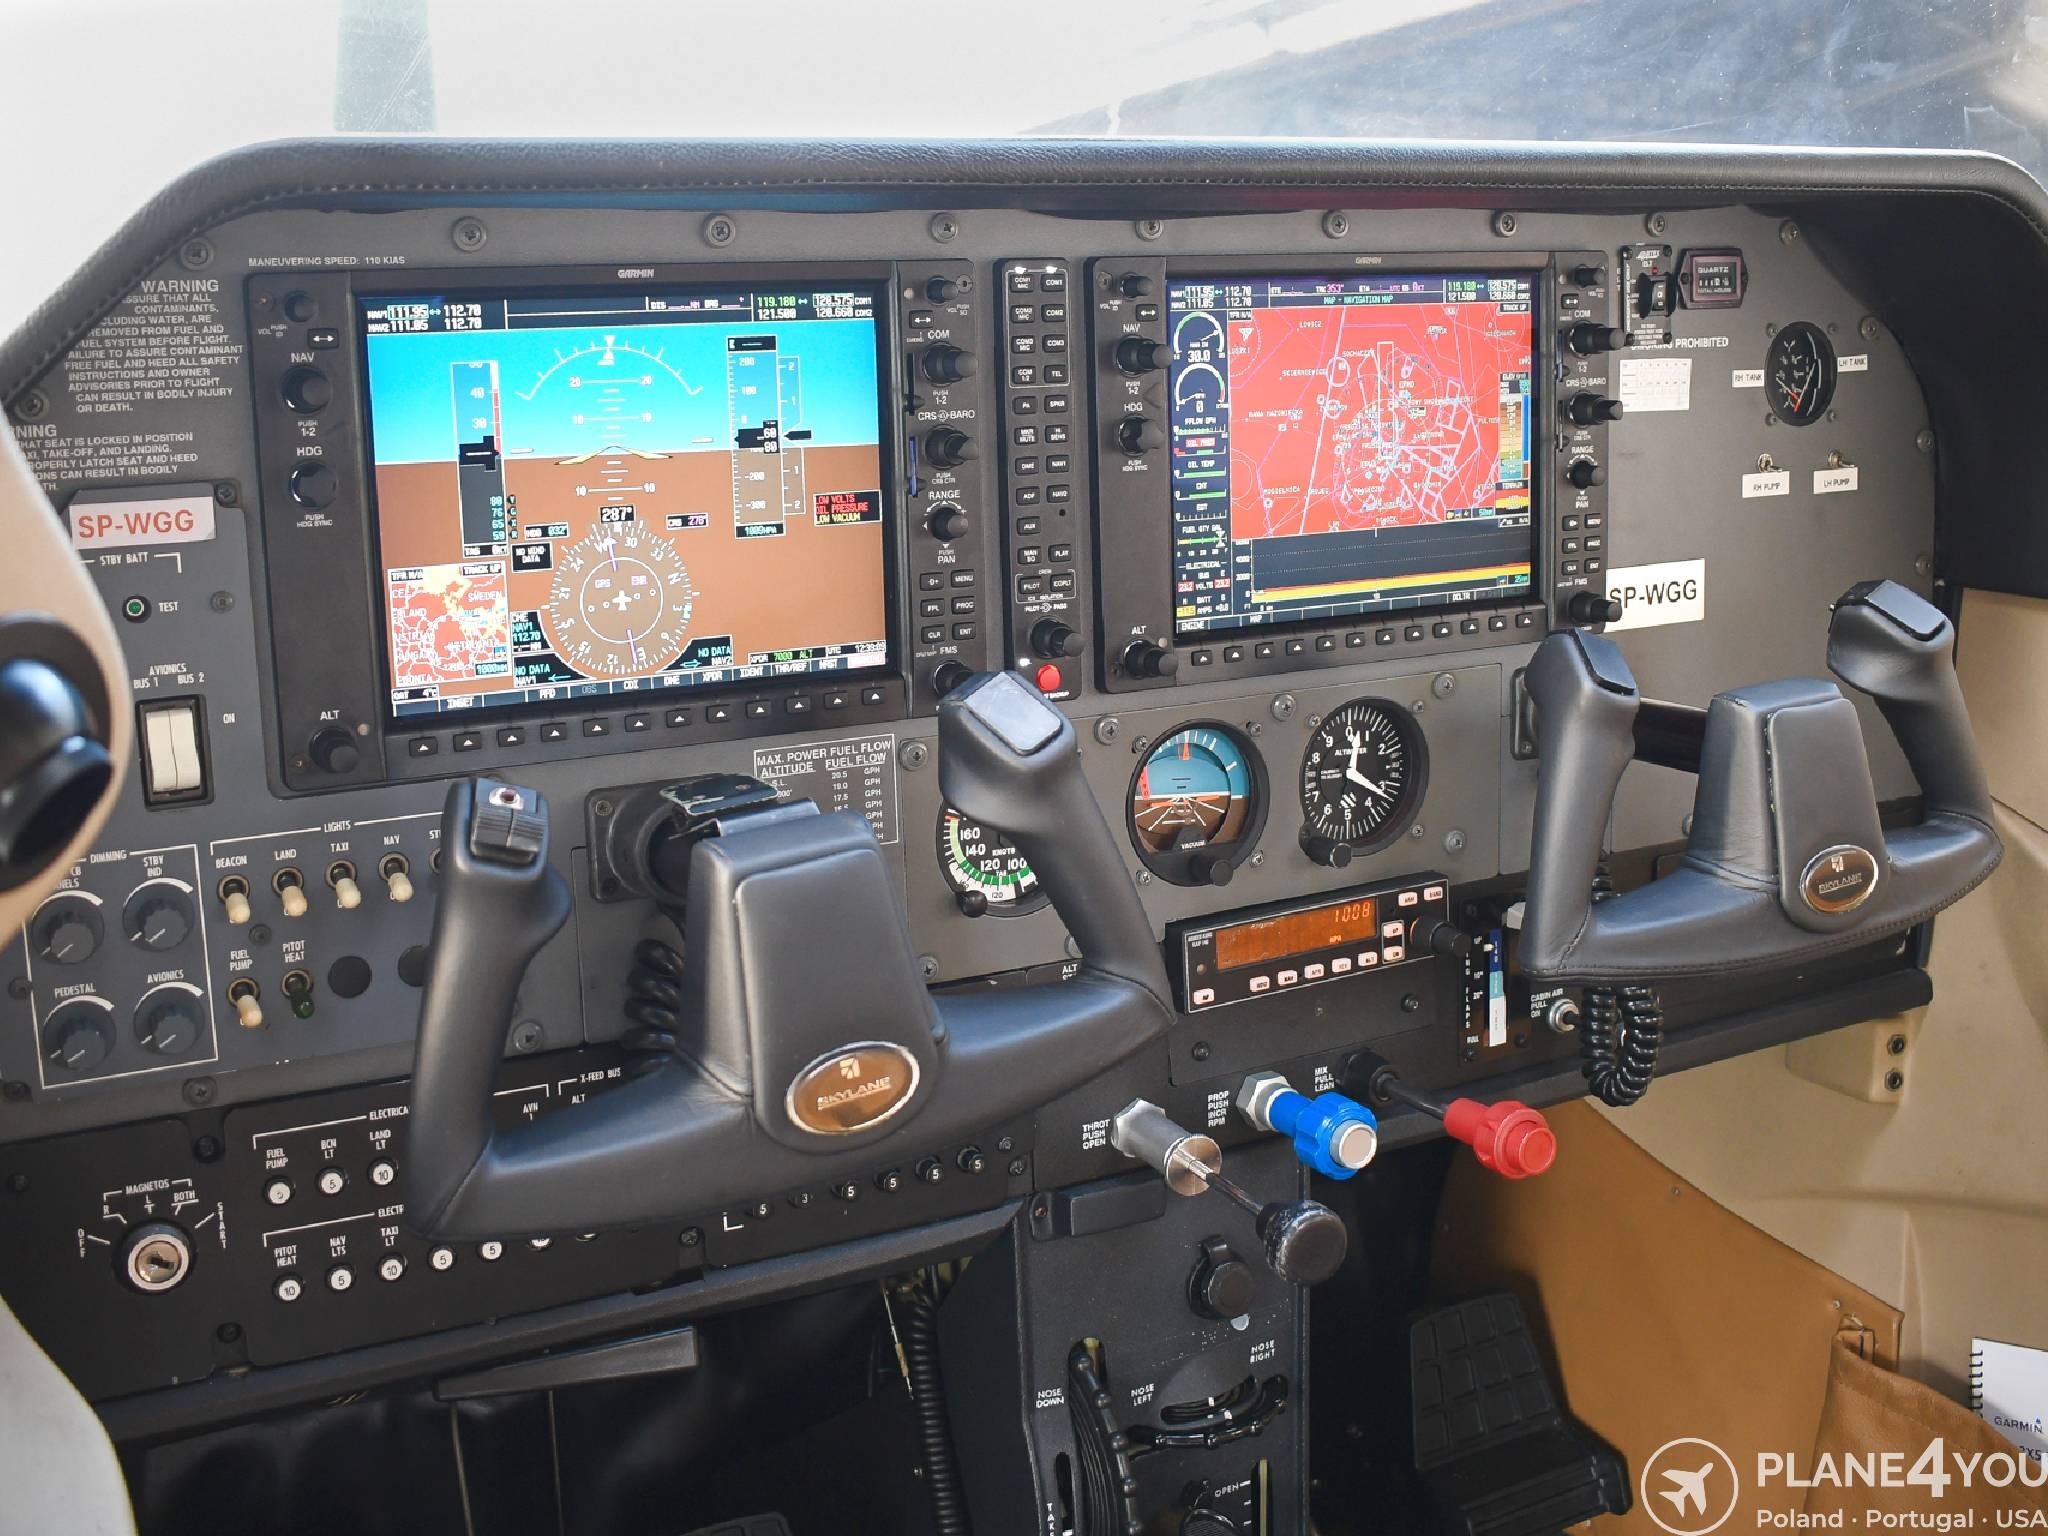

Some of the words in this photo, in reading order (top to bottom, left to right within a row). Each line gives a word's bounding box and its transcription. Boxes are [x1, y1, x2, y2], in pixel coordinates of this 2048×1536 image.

[249, 257, 321, 267] MANEUVERING
[365, 256, 381, 264] 110
[383, 256, 405, 264] KIAS
[618, 269, 654, 278] GARMIN
[142, 279, 219, 292] WARNING
[1123, 324, 1140, 332] NAV
[928, 330, 950, 339] COM
[1675, 337, 1729, 348] PROHIBITED
[126, 348, 167, 357] ASSURE
[170, 345, 242, 355] CONTAMINANT
[64, 362, 92, 370] FREE
[95, 361, 121, 369] FUEL
[124, 360, 146, 368] AND
[150, 358, 176, 367] HEED
[201, 356, 239, 364] SAFETY
[291, 353, 314, 363] NAV
[1839, 359, 1847, 367] LH
[1849, 358, 1866, 367] TANK
[69, 371, 145, 380] INSTRUCTIONS
[148, 369, 169, 377] AND
[172, 368, 210, 376] OWNER
[69, 381, 130, 391] ADVISORIES
[134, 380, 165, 388] PRIOR
[168, 380, 181, 388] TO
[185, 378, 220, 387] FLIGHT
[76, 394, 98, 402] CAN
[102, 392, 141, 400] RESULT
[144, 391, 154, 399] IN
[158, 390, 194, 398] BODILY
[198, 388, 232, 397] INJURY
[95, 402, 133, 412] DEATH.
[1124, 403, 1142, 412] HDG
[44, 438, 72, 447] SEAT
[75, 438, 84, 446] IS
[88, 436, 129, 445] LOCKED
[133, 435, 142, 443] IN
[146, 432, 192, 442] POSITION
[297, 447, 322, 456] HDG
[1572, 446, 1594, 454] RANGE
[1824, 480, 1831, 488] LH
[1833, 479, 1849, 487] PUMP
[816, 497, 829, 505] LOW
[832, 495, 855, 503] VOLTS
[928, 490, 960, 500] RANGE
[816, 506, 829, 514] OIL
[831, 503, 868, 512] PRESSURE
[79, 509, 193, 538] SP-WGG
[816, 515, 829, 523] LOW
[832, 513, 860, 521] VACUUM
[100, 555, 121, 565] STBY
[126, 552, 148, 563] BATT
[938, 556, 955, 564] PAN
[1609, 579, 1697, 608] SP-WGG
[159, 602, 177, 612] TEST
[512, 623, 532, 632] NAV1
[1132, 626, 1146, 634] ALT
[698, 648, 709, 656] NO
[774, 652, 792, 661] 7000
[150, 664, 186, 675] AVIONICS
[515, 666, 526, 676] NO
[529, 664, 550, 674] DATA
[740, 669, 763, 677] IDENT
[703, 672, 722, 681] XPDR
[223, 714, 234, 723] ON
[320, 710, 339, 719] ALT
[757, 754, 784, 766] MAX.
[788, 749, 826, 762] POWER
[830, 746, 857, 756] FUEL
[861, 740, 890, 753] FLOW
[762, 762, 814, 776] ALTITUDE
[826, 757, 852, 768] FUEL
[856, 753, 886, 765] FLOW
[864, 766, 880, 774] GPH
[864, 778, 880, 786] GPH
[865, 789, 881, 797] GPH
[325, 821, 351, 832] LIGHTS
[960, 828, 980, 840] 160
[384, 835, 400, 845] NAV
[331, 842, 349, 853] TAXI
[966, 844, 986, 856] 140
[91, 850, 127, 863] DIMMING
[276, 849, 296, 860] LAND
[144, 856, 164, 866] STBY
[216, 856, 247, 867] BEACON
[980, 860, 1000, 872] 120
[1008, 858, 1027, 870] 100
[147, 867, 162, 877] IND
[1334, 902, 1370, 923] 1008
[283, 941, 305, 952] PITOT
[231, 950, 248, 959] FUEL
[285, 951, 304, 962] HEAT
[230, 959, 252, 971] PUMP
[1062, 964, 1077, 974] ALT
[148, 970, 184, 983] AVIONICS
[55, 985, 96, 997] PEDESTAL
[1531, 992, 1550, 1001] CABIN
[1551, 988, 1563, 997] AIR
[1531, 1002, 1547, 1010] PULL
[1531, 1010, 1541, 1018] ON
[1314, 1066, 1328, 1076] MIX
[1315, 1074, 1332, 1084] PULL
[1314, 1082, 1334, 1092] LEAN
[817, 1076, 891, 1110] SKYLANE
[1208, 1090, 1228, 1102] PROP
[1208, 1100, 1228, 1110] PUSH
[1208, 1108, 1226, 1118] INCR
[1082, 1119, 1110, 1132] THROT
[1208, 1117, 1225, 1127] RPM
[369, 1130, 390, 1140] LAND
[1082, 1130, 1106, 1140] PUSH
[1082, 1138, 1106, 1150] OPEN
[267, 1149, 285, 1158] FUEL
[266, 1157, 287, 1168] PUMP
[126, 1180, 169, 1194] MAGNETOS
[174, 1190, 195, 1201] BOTH
[381, 1226, 398, 1237] TAXI
[330, 1236, 346, 1246] NAV
[274, 1246, 297, 1256] PITOT
[276, 1255, 297, 1265] HEAT
[1252, 1340, 1274, 1353] NOSE
[1250, 1348, 1275, 1363] RIGHT
[1038, 1388, 1062, 1398] NOSE
[1131, 1384, 1154, 1397] NOSE
[1036, 1396, 1064, 1408] DOWN
[1134, 1394, 1152, 1406] LEFT
[1994, 1416, 2042, 1433] GARMIN
[1215, 1484, 1239, 1498] OPEN
